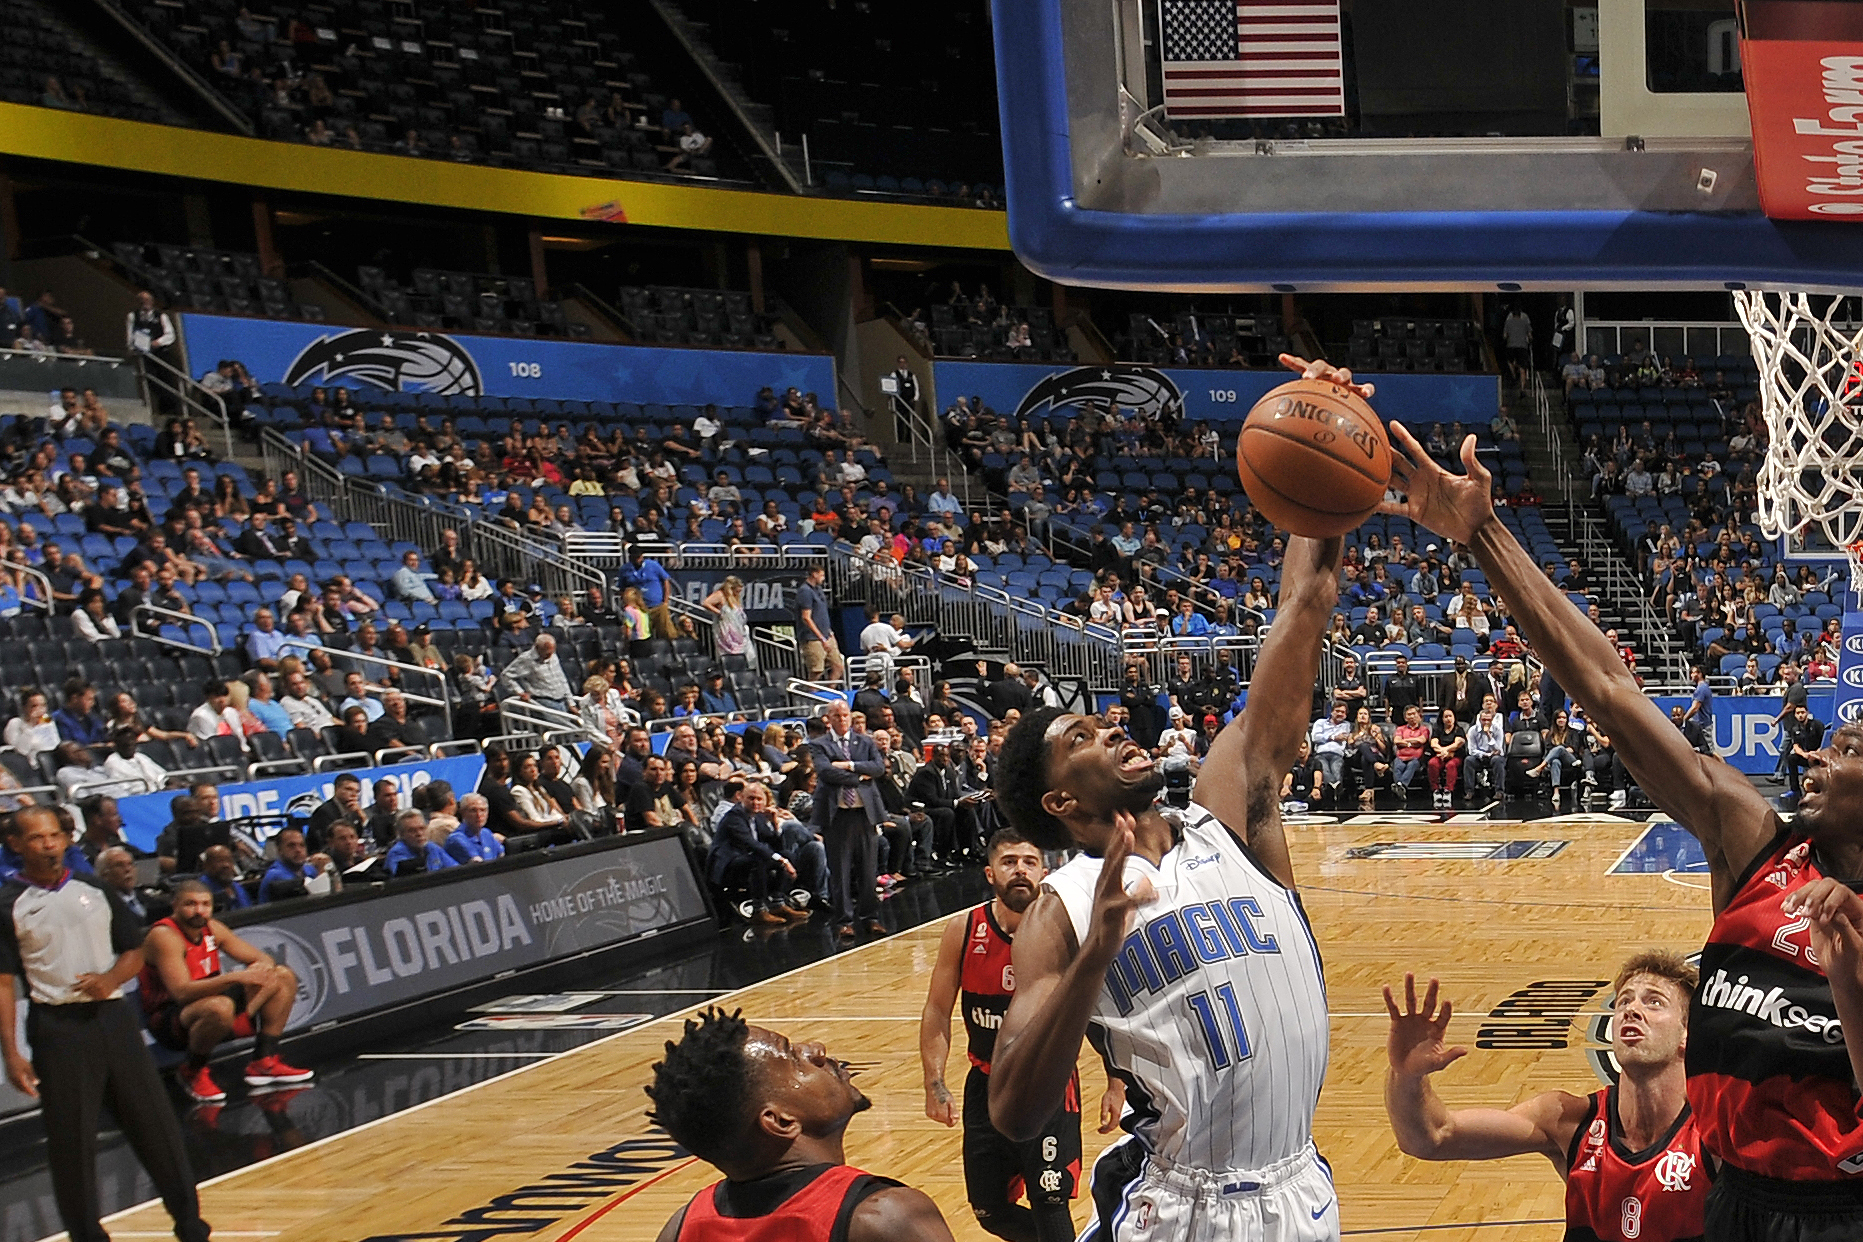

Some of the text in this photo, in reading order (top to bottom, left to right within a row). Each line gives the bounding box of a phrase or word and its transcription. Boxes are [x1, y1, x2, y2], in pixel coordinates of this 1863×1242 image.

[508, 362, 542, 378] 108
[1209, 390, 1237, 403] 109
[1274, 397, 1378, 459] SPALDING
[686, 581, 785, 610] FLIDA
[321, 874, 667, 994] FLORIDA HOME OF THE MAGIC
[1104, 897, 1281, 1018] MAGIC
[1186, 981, 1252, 1071] 11
[1475, 980, 1612, 1049] ORLANDO
[1042, 1136, 1058, 1161] 6
[1621, 1196, 1642, 1239] 8
